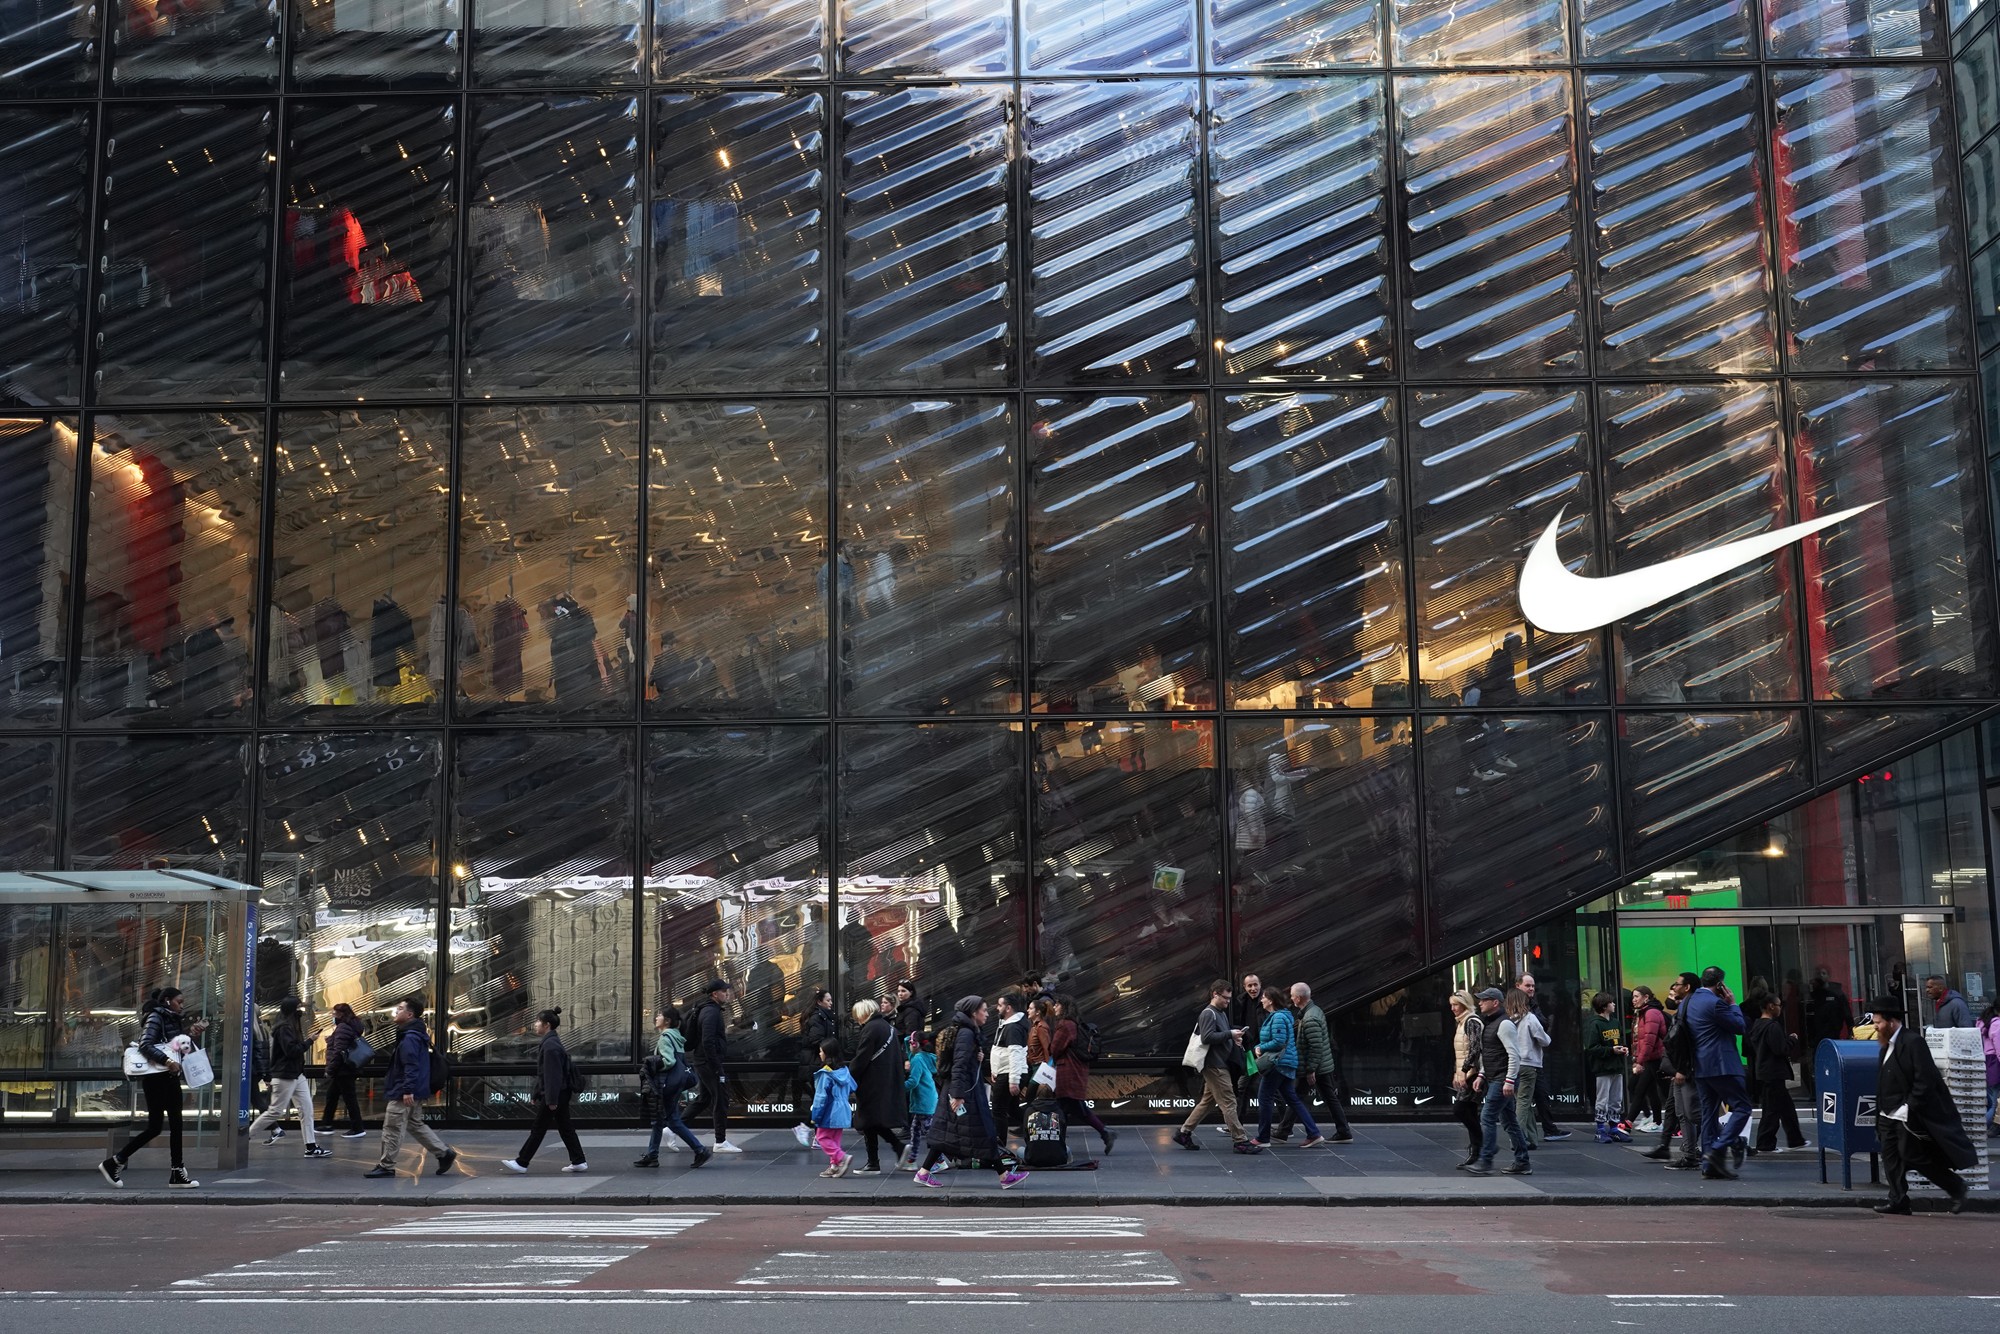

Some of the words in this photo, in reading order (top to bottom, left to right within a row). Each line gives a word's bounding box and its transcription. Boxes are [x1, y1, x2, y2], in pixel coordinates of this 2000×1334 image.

[245, 933, 253, 977] Avenue
[245, 980, 251, 988] &
[243, 992, 251, 1023] West
[242, 1027, 249, 1042] 52
[241, 1045, 249, 1082] Street
[1148, 1099, 1171, 1108] NIKE
[1173, 1099, 1196, 1108] KIDS
[1351, 1096, 1373, 1106] NIKE
[1375, 1096, 1398, 1106] KIDS
[747, 1103, 769, 1113] NIKE
[771, 1103, 794, 1113] KIDS
